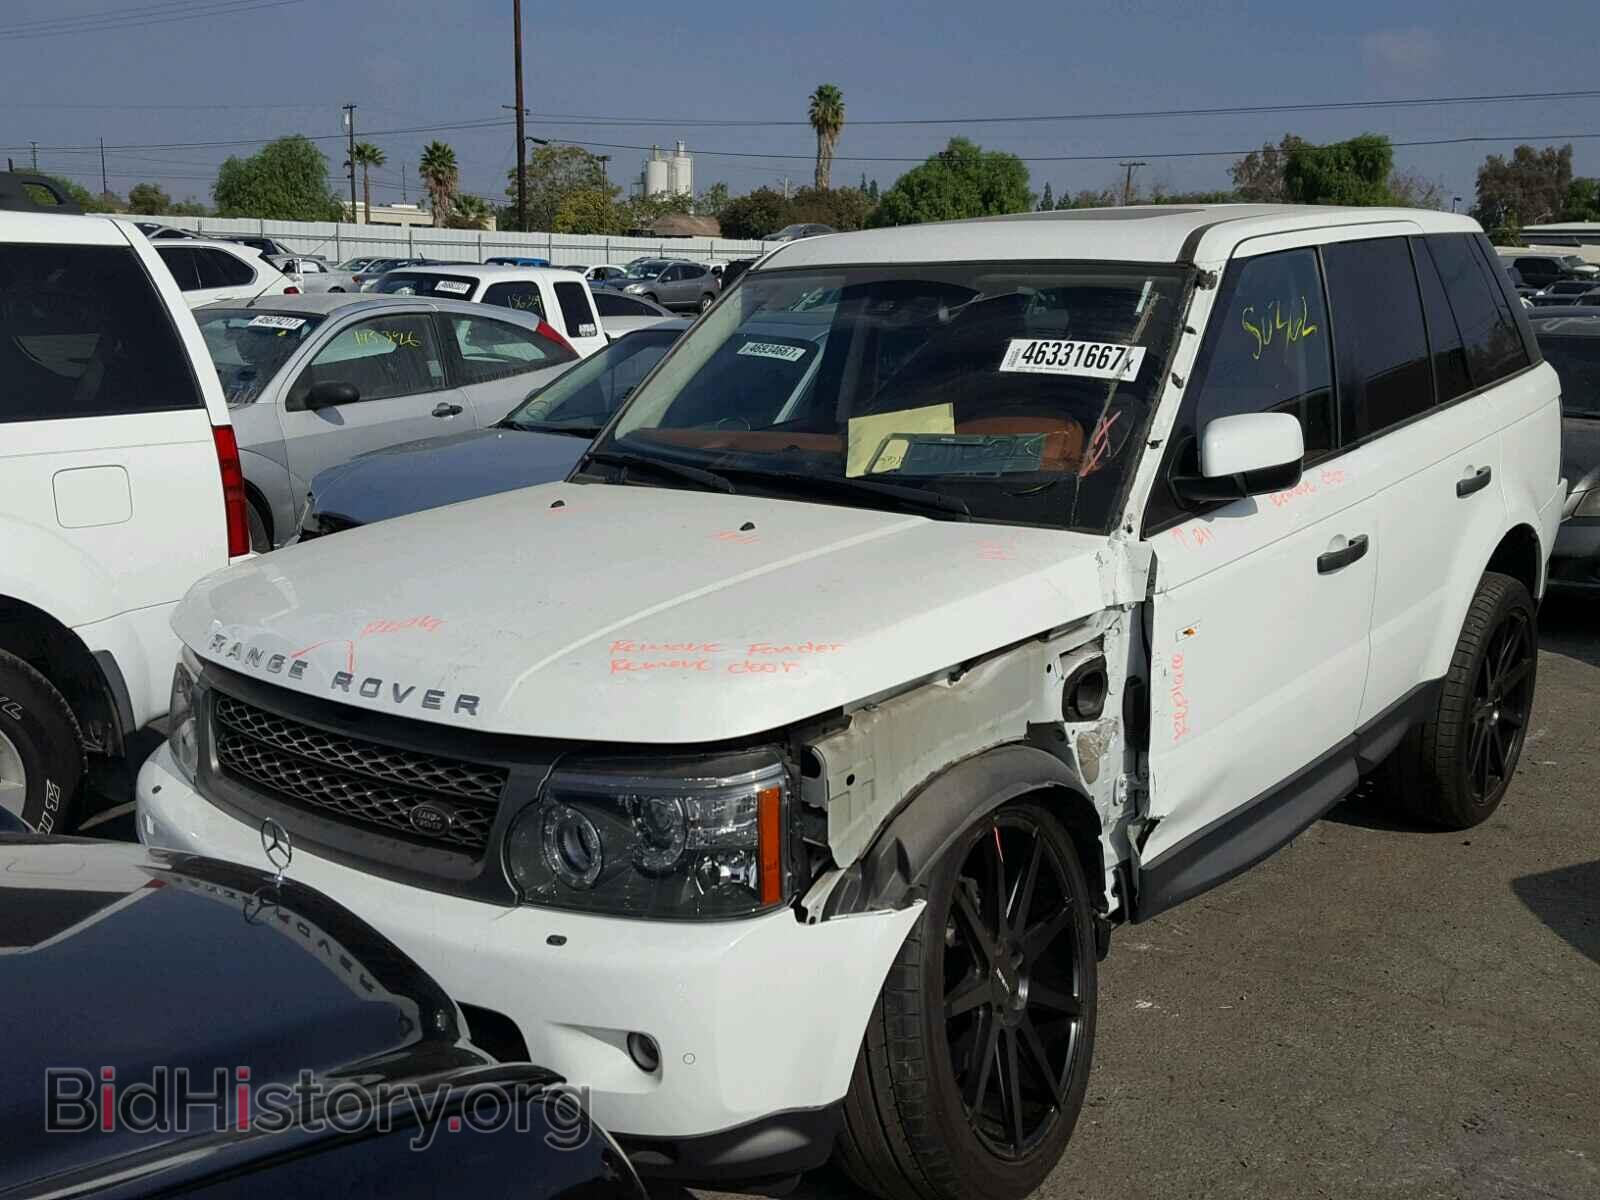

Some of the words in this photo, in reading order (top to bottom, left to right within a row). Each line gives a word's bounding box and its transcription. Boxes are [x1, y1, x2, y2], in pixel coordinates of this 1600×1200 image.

[1021, 341, 1126, 371] 46331667
[208, 633, 309, 680] RANGE
[331, 671, 481, 716] ROVER
